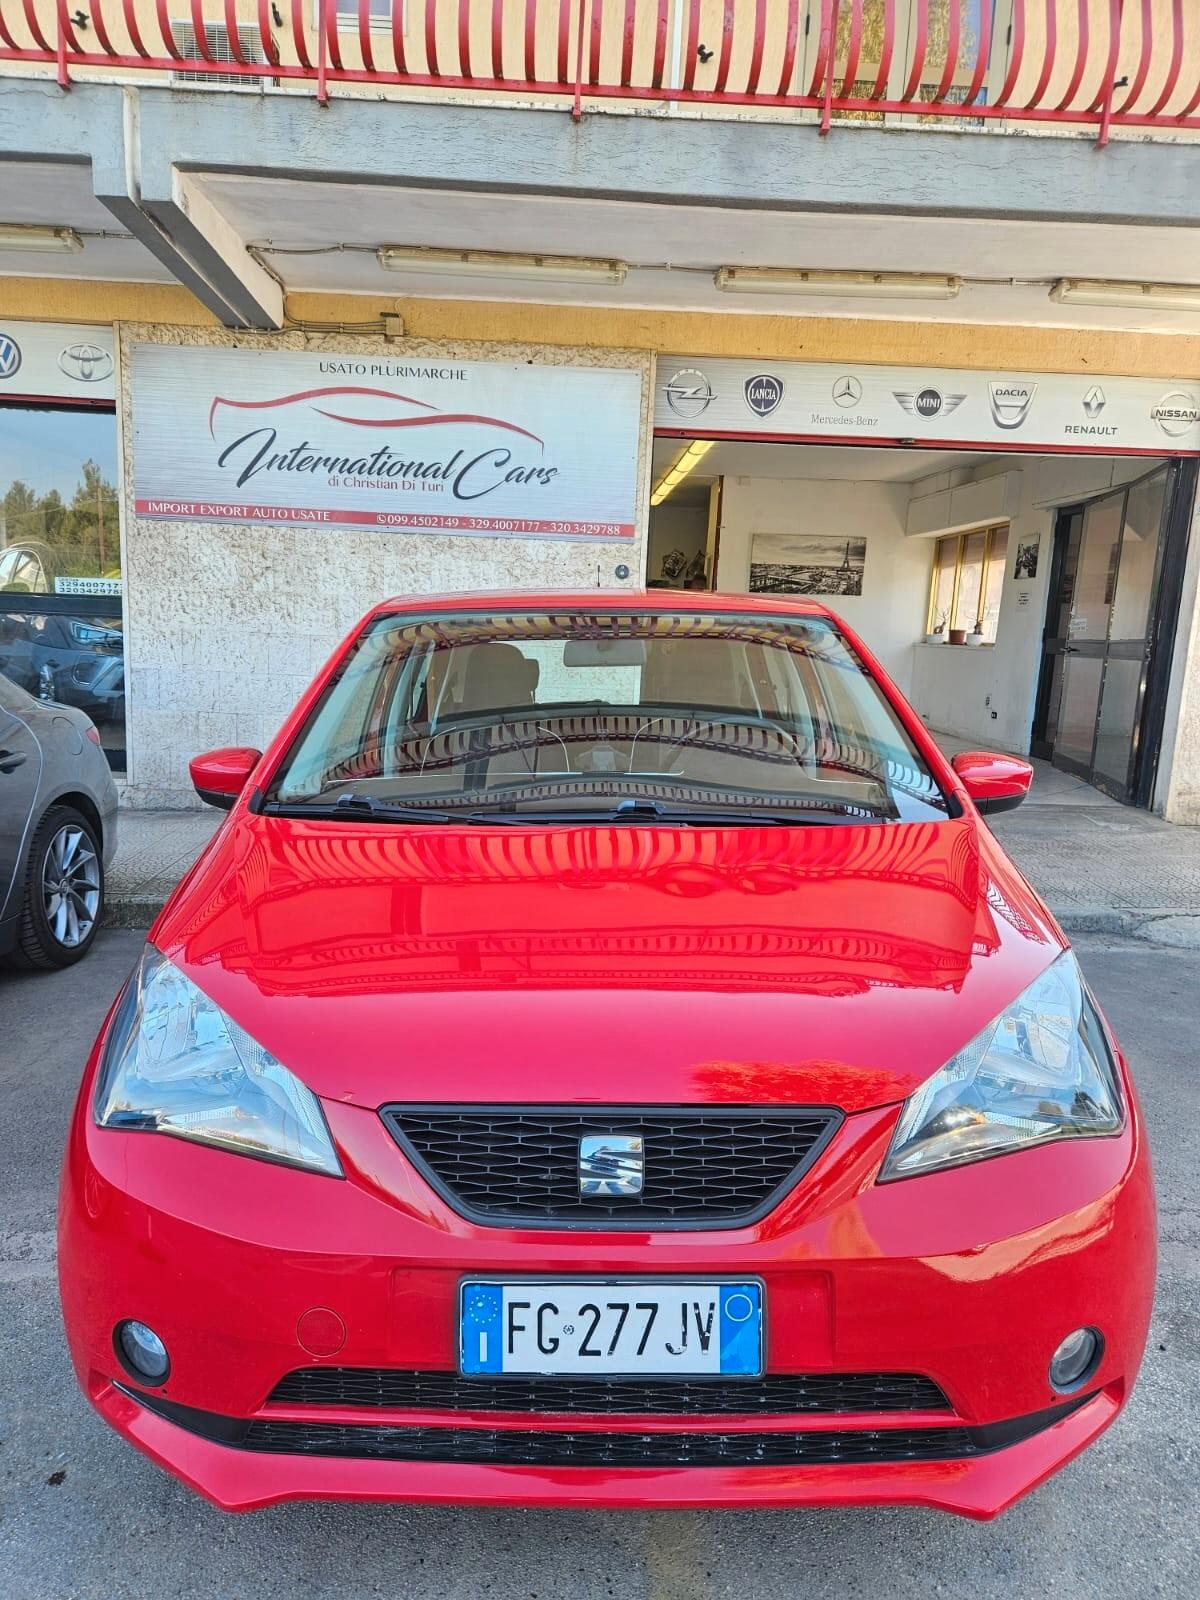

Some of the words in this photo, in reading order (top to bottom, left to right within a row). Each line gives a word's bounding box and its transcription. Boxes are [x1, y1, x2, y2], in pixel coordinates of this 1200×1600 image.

[319, 361, 367, 375] USATO
[371, 364, 468, 381] PLURIMARCHE
[751, 388, 777, 400] LANCIA
[995, 388, 1028, 397] DACIA
[917, 398, 941, 408] MINI
[811, 414, 879, 426] Mercedes-Benz
[1155, 409, 1198, 419] NISSAN
[1065, 425, 1118, 436] RENAULT
[218, 427, 464, 489] International
[452, 448, 561, 500] Cars
[328, 475, 339, 487] di
[343, 476, 398, 490] Christian
[402, 480, 415, 491] Di
[421, 481, 444, 492] Turi
[148, 502, 196, 514] IMPORT
[200, 504, 249, 517] EXPORT
[252, 507, 288, 519] AUTO
[291, 509, 331, 521] USATE
[387, 515, 459, 528] 099.4502149
[469, 519, 540, 532] 329.4007177
[550, 523, 621, 536] 320.3429788
